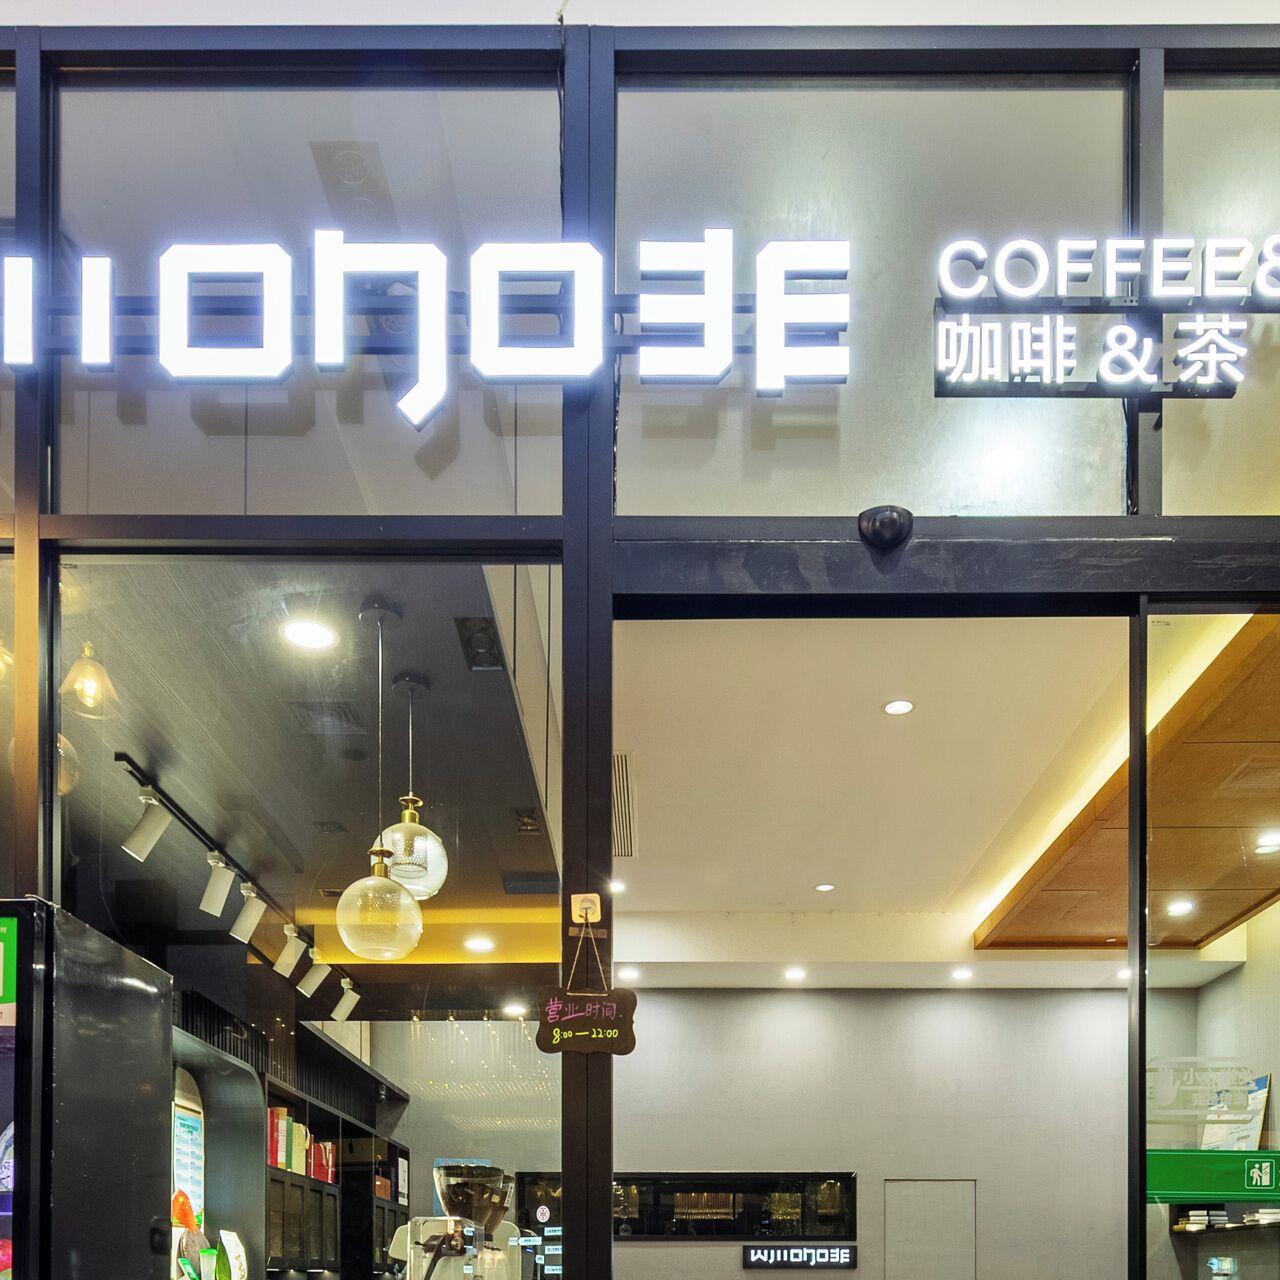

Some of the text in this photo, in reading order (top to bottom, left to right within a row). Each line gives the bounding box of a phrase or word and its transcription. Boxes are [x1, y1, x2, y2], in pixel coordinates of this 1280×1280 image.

[937, 314, 1248, 385] 咖啡 & 茶
